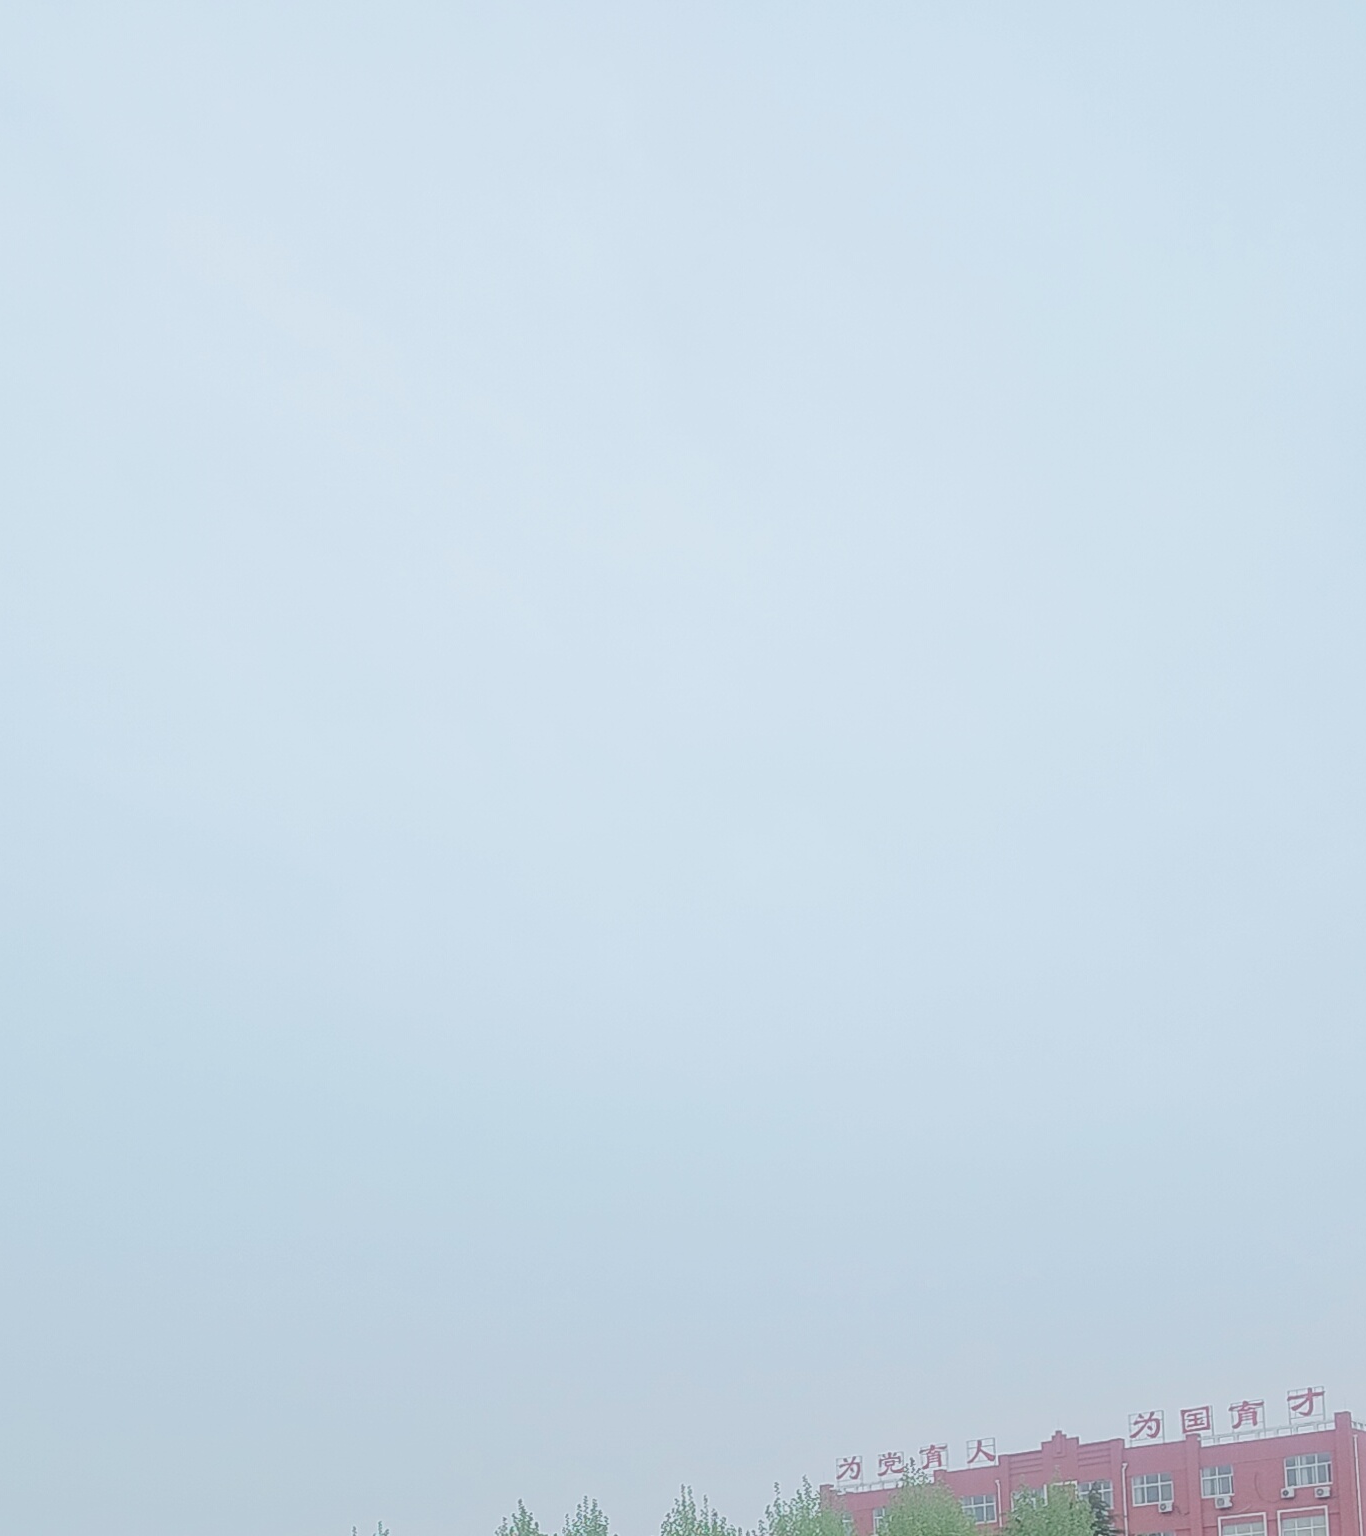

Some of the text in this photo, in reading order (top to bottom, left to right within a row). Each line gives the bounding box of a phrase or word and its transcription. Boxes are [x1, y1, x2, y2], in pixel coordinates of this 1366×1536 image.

[1130, 1387, 1325, 1440] 为国育才
[837, 1437, 996, 1480] 为党育人
